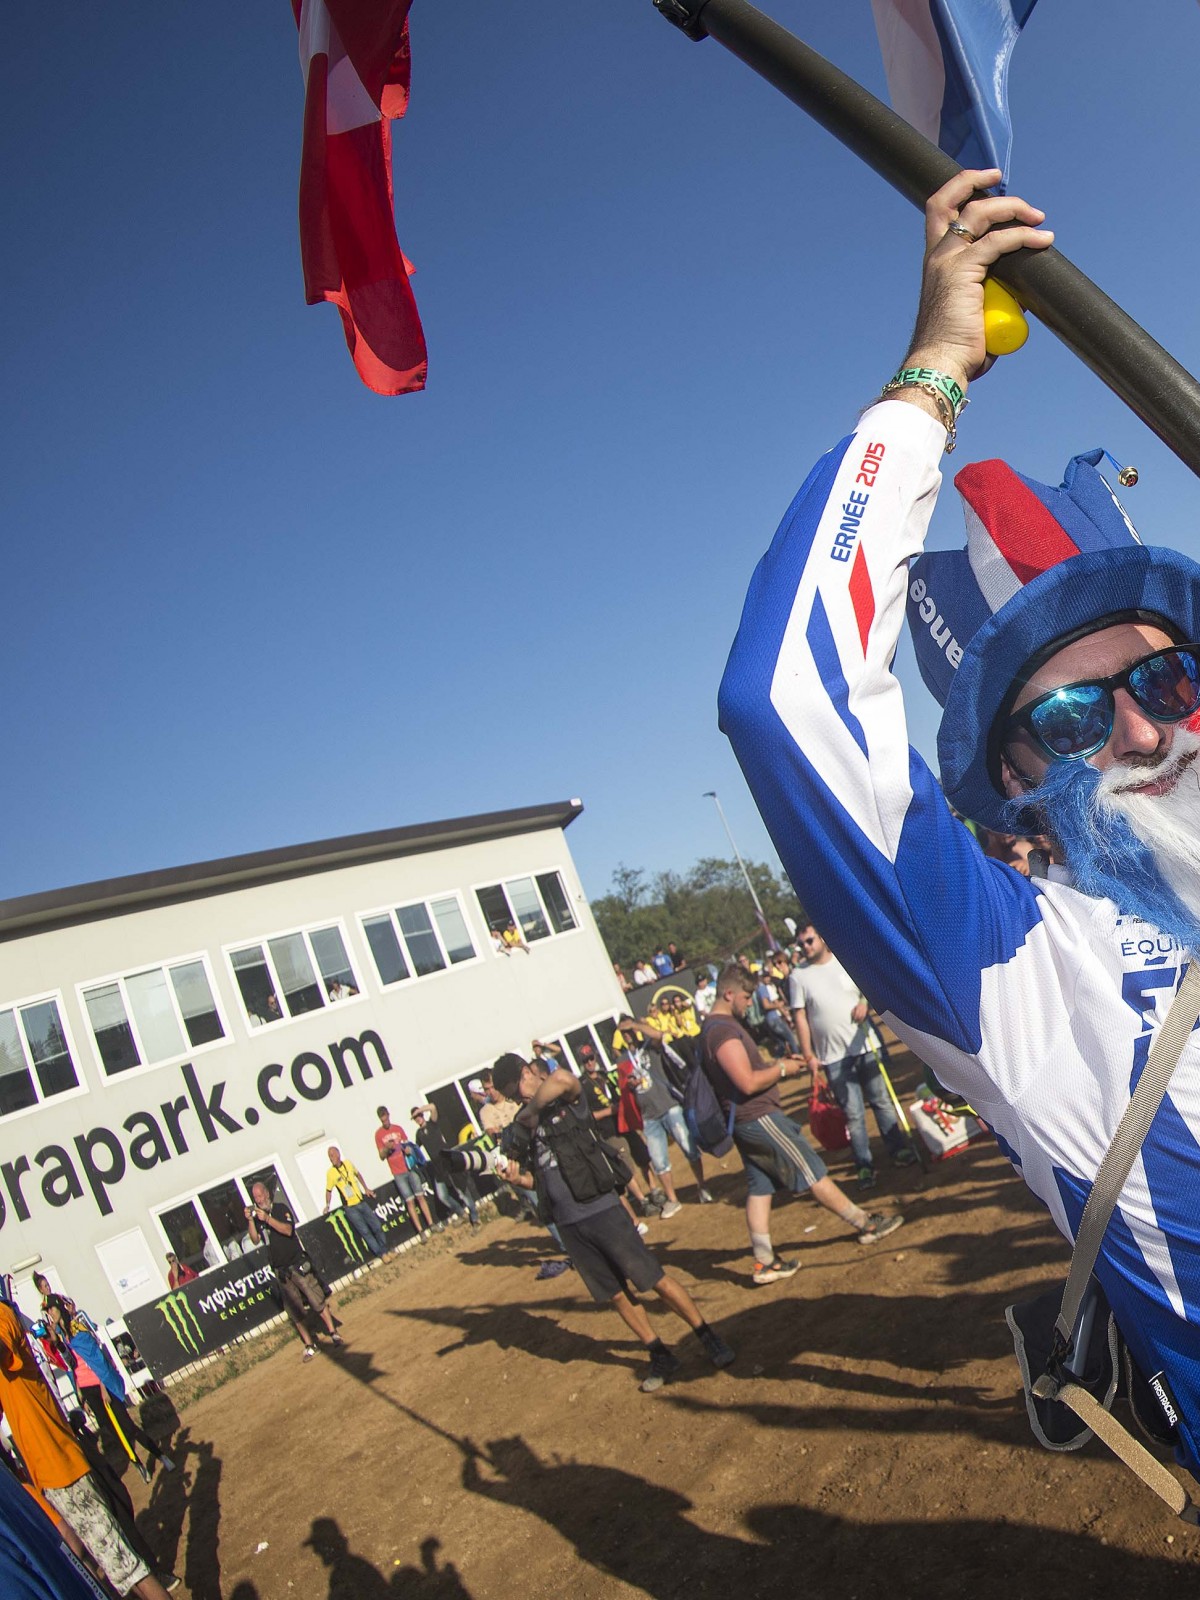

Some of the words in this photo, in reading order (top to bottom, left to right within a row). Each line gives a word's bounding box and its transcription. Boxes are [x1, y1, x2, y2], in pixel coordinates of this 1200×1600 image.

[855, 442, 886, 487] 2015
[830, 490, 870, 562] ERNÉE
[0, 1029, 393, 1231] rapark.com
[198, 1264, 276, 1314] MONSTER
[219, 1288, 272, 1321] ENERGY
